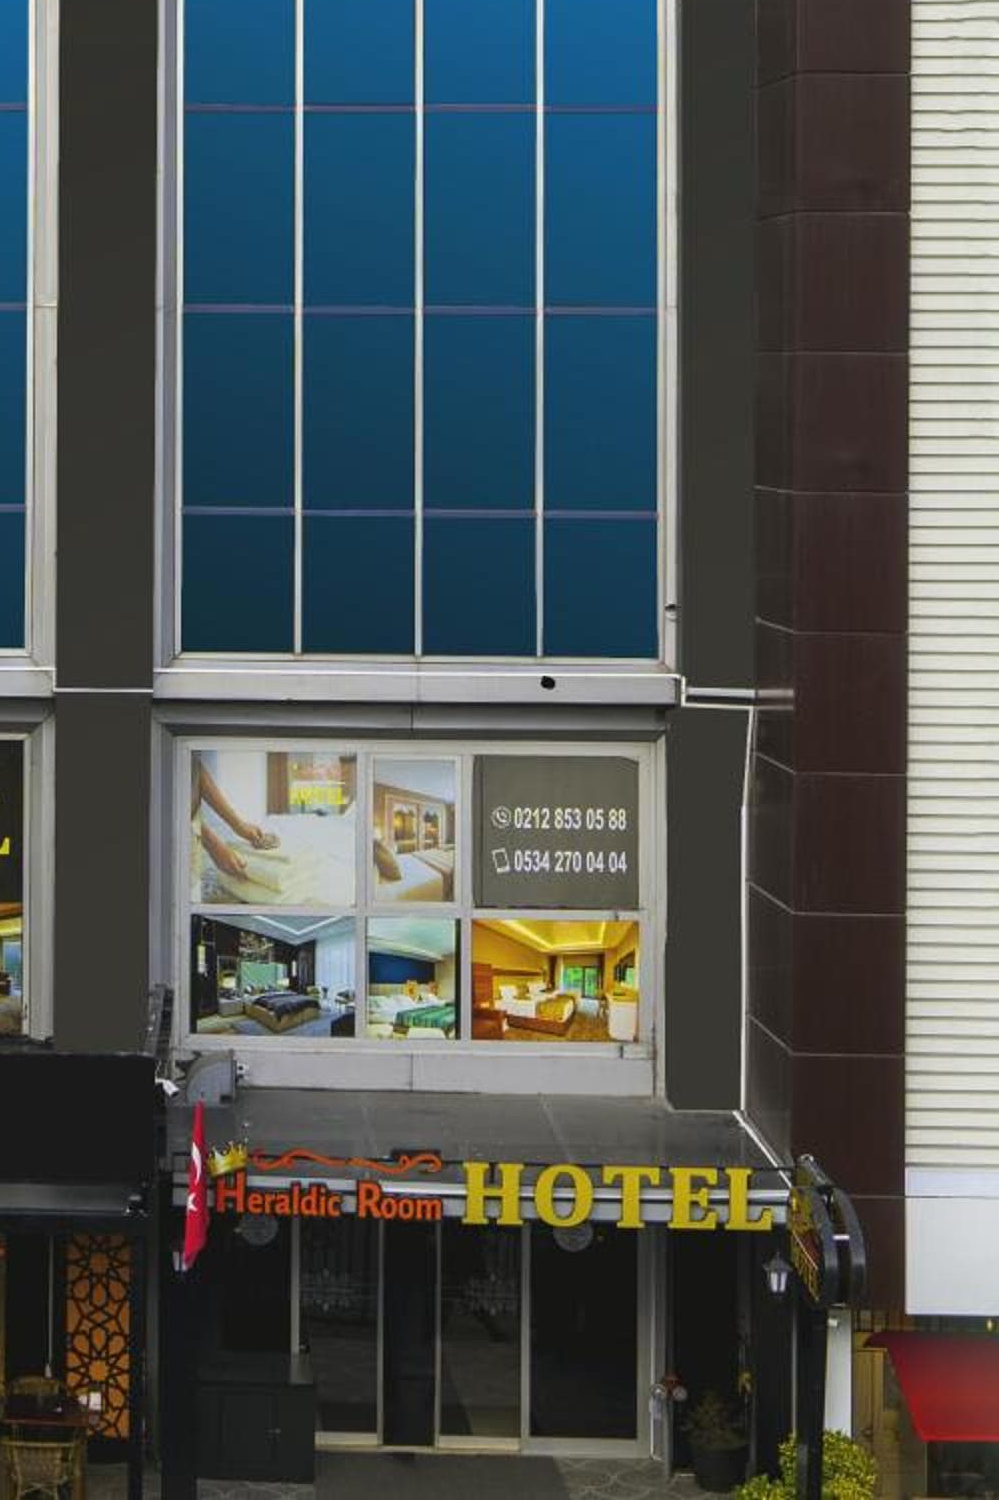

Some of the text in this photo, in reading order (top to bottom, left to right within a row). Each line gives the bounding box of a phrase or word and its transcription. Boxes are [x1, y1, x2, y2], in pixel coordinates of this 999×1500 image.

[513, 807, 627, 831] 0212 853 05 88
[513, 850, 627, 873] 0534 270 04 04
[215, 1161, 773, 1232] Heraldic Room HOTEL
